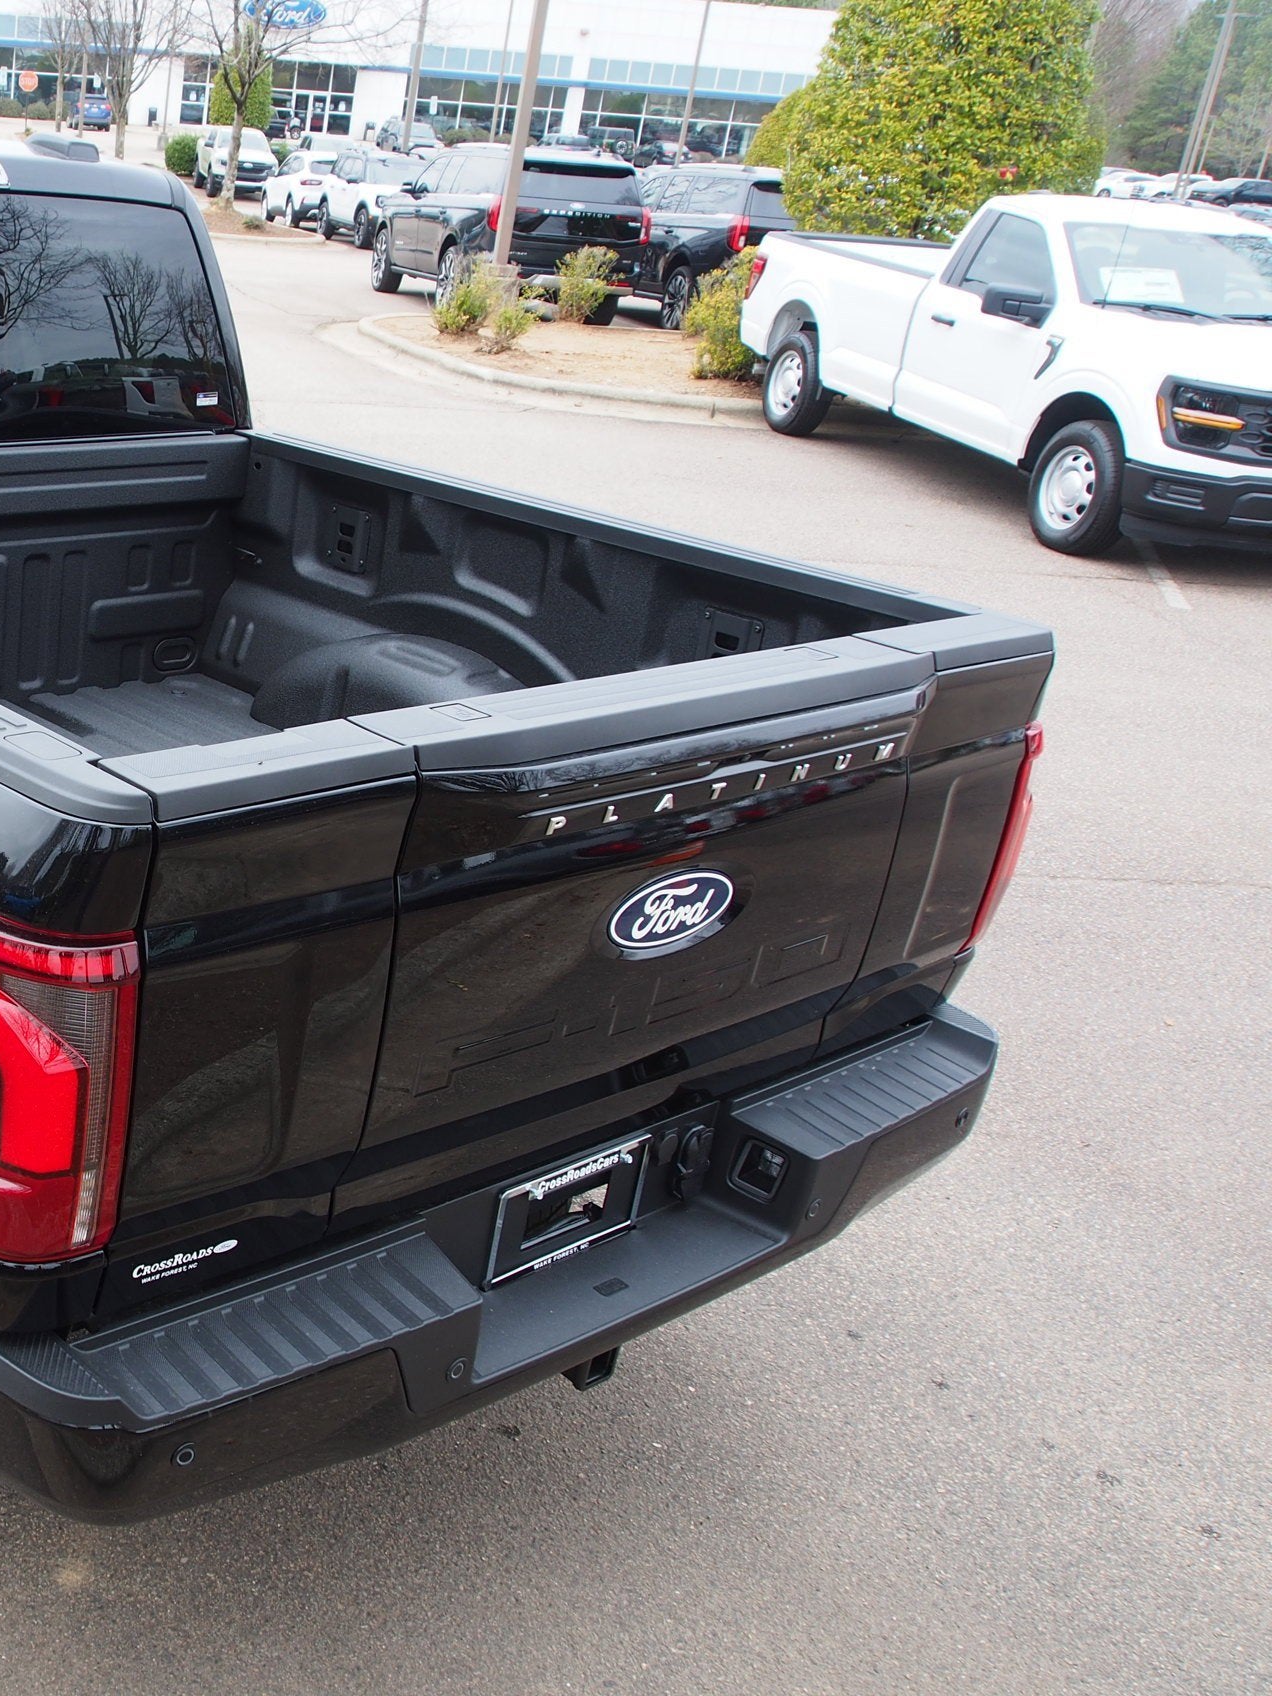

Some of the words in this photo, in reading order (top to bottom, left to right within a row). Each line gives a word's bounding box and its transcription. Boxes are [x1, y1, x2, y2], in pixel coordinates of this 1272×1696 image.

[545, 742, 895, 836] PLATINUM
[631, 883, 715, 940] Ford
[538, 1152, 620, 1194] CrossRoadsCars
[141, 1273, 160, 1284] WAKE
[188, 1262, 199, 1270] NC
[533, 1258, 552, 1270] WAKE
[580, 1242, 590, 1250] NC
